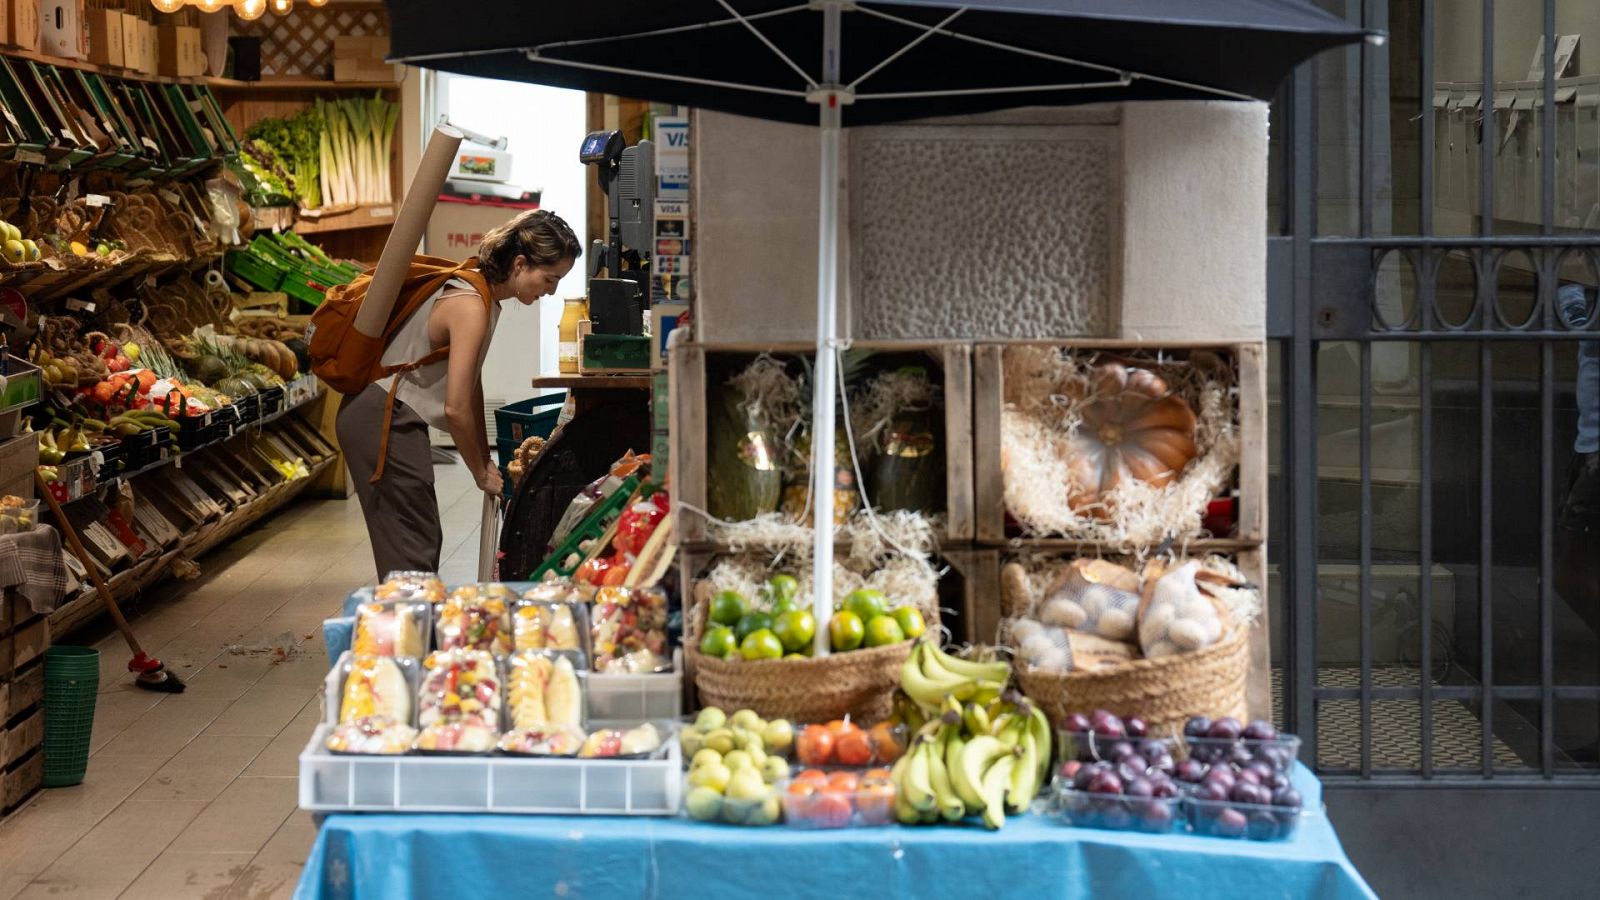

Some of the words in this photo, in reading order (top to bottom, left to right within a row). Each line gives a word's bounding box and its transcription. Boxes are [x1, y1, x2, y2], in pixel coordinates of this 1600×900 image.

[667, 133, 689, 147] VIS
[660, 205, 681, 213] VISA
[448, 232, 482, 247] INF
